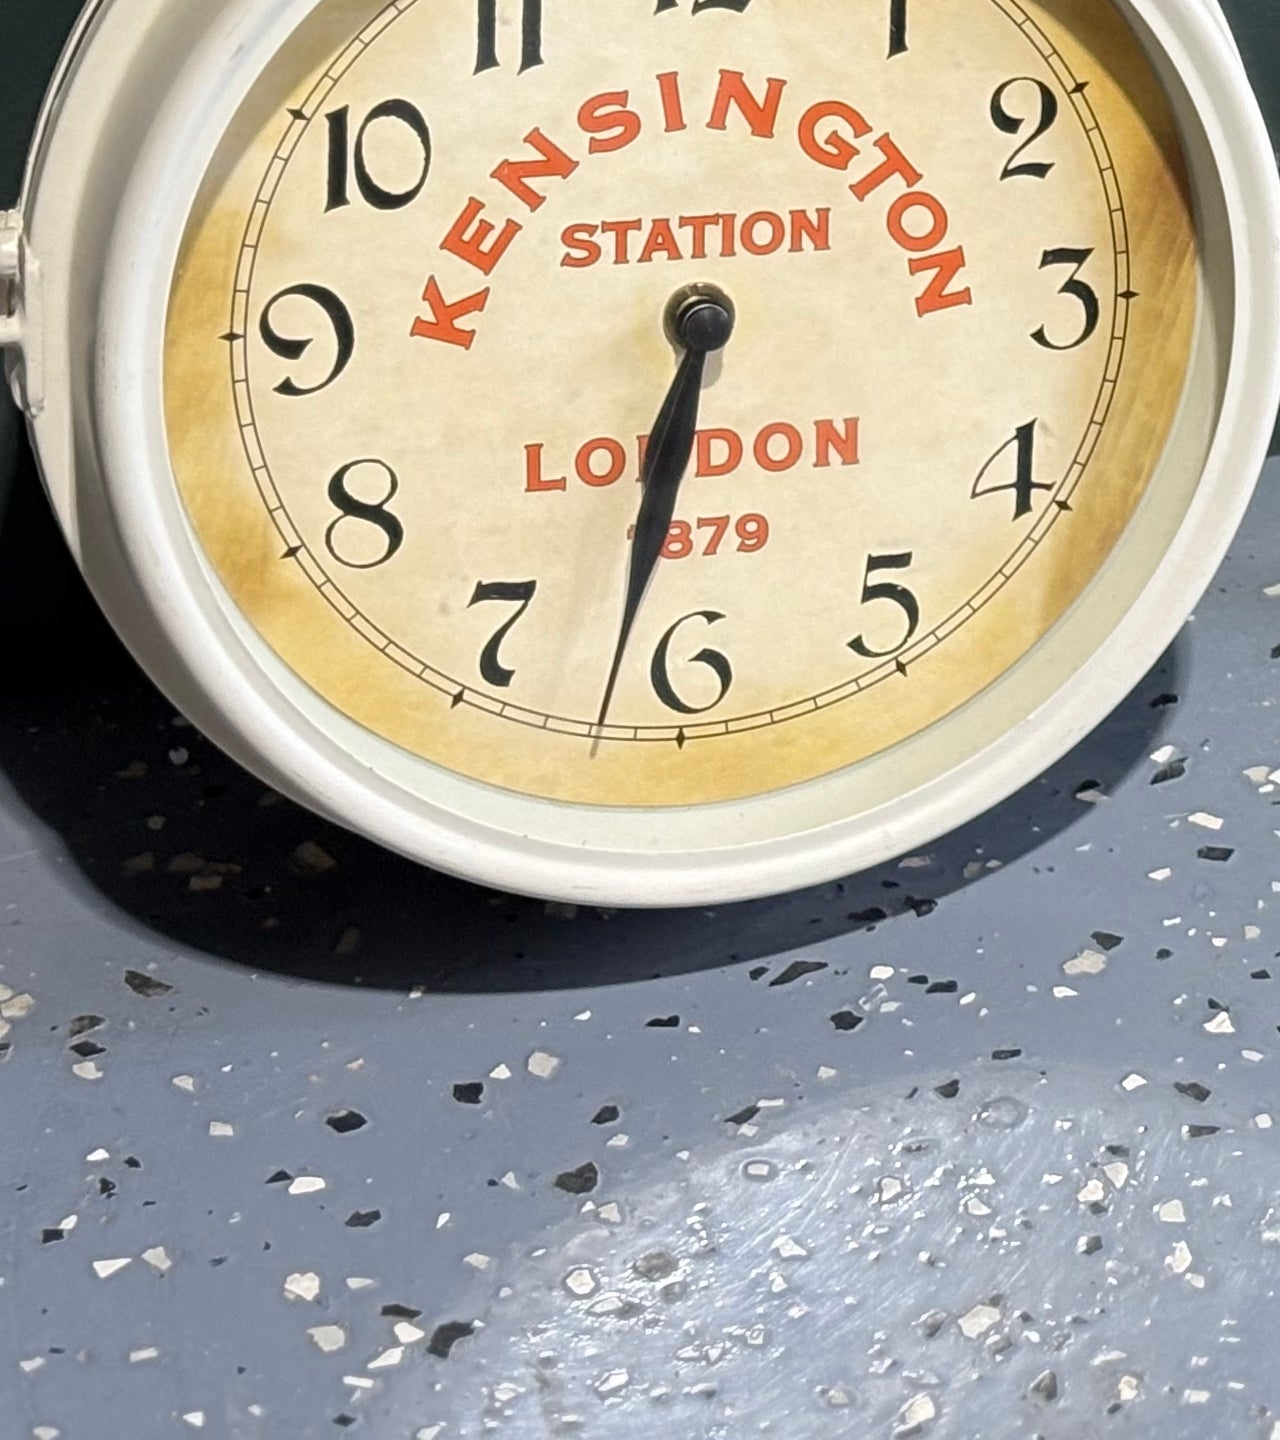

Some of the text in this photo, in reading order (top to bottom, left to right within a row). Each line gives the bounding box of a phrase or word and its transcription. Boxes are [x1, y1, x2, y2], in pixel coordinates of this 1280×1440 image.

[323, 97, 432, 212] 10
[989, 76, 1059, 180] 2
[409, 68, 971, 348] KENSINGTON
[559, 207, 831, 268] STATION
[258, 282, 355, 397] 9
[1030, 246, 1099, 350] 3
[524, 417, 860, 492] LODON
[969, 417, 1056, 520] 4
[324, 457, 404, 569] 8
[627, 513, 769, 560] 879
[467, 578, 537, 688] 7
[845, 550, 919, 658] 5
[650, 610, 733, 715] 6
